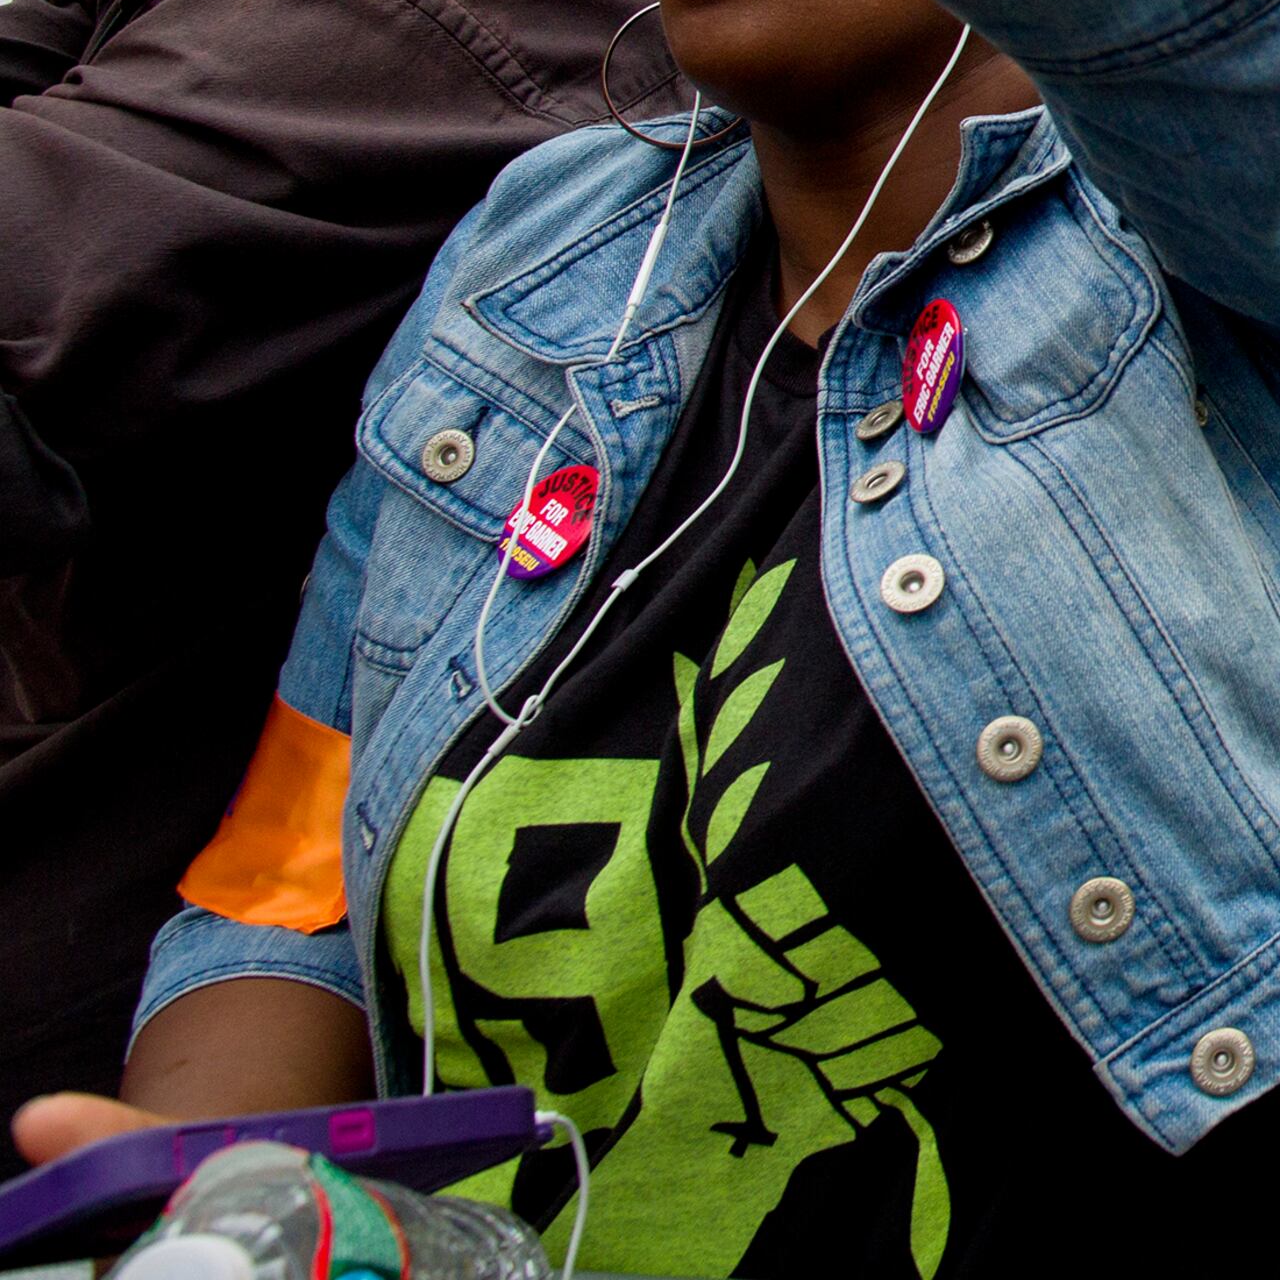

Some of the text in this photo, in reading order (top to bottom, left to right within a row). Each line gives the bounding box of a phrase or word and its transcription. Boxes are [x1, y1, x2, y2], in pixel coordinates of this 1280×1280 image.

[913, 321, 955, 424] ERIC GARNER
[916, 338, 935, 380] FOR
[538, 472, 595, 526] JUSTICE
[540, 498, 569, 526] FOR
[525, 520, 568, 561] GARNER
